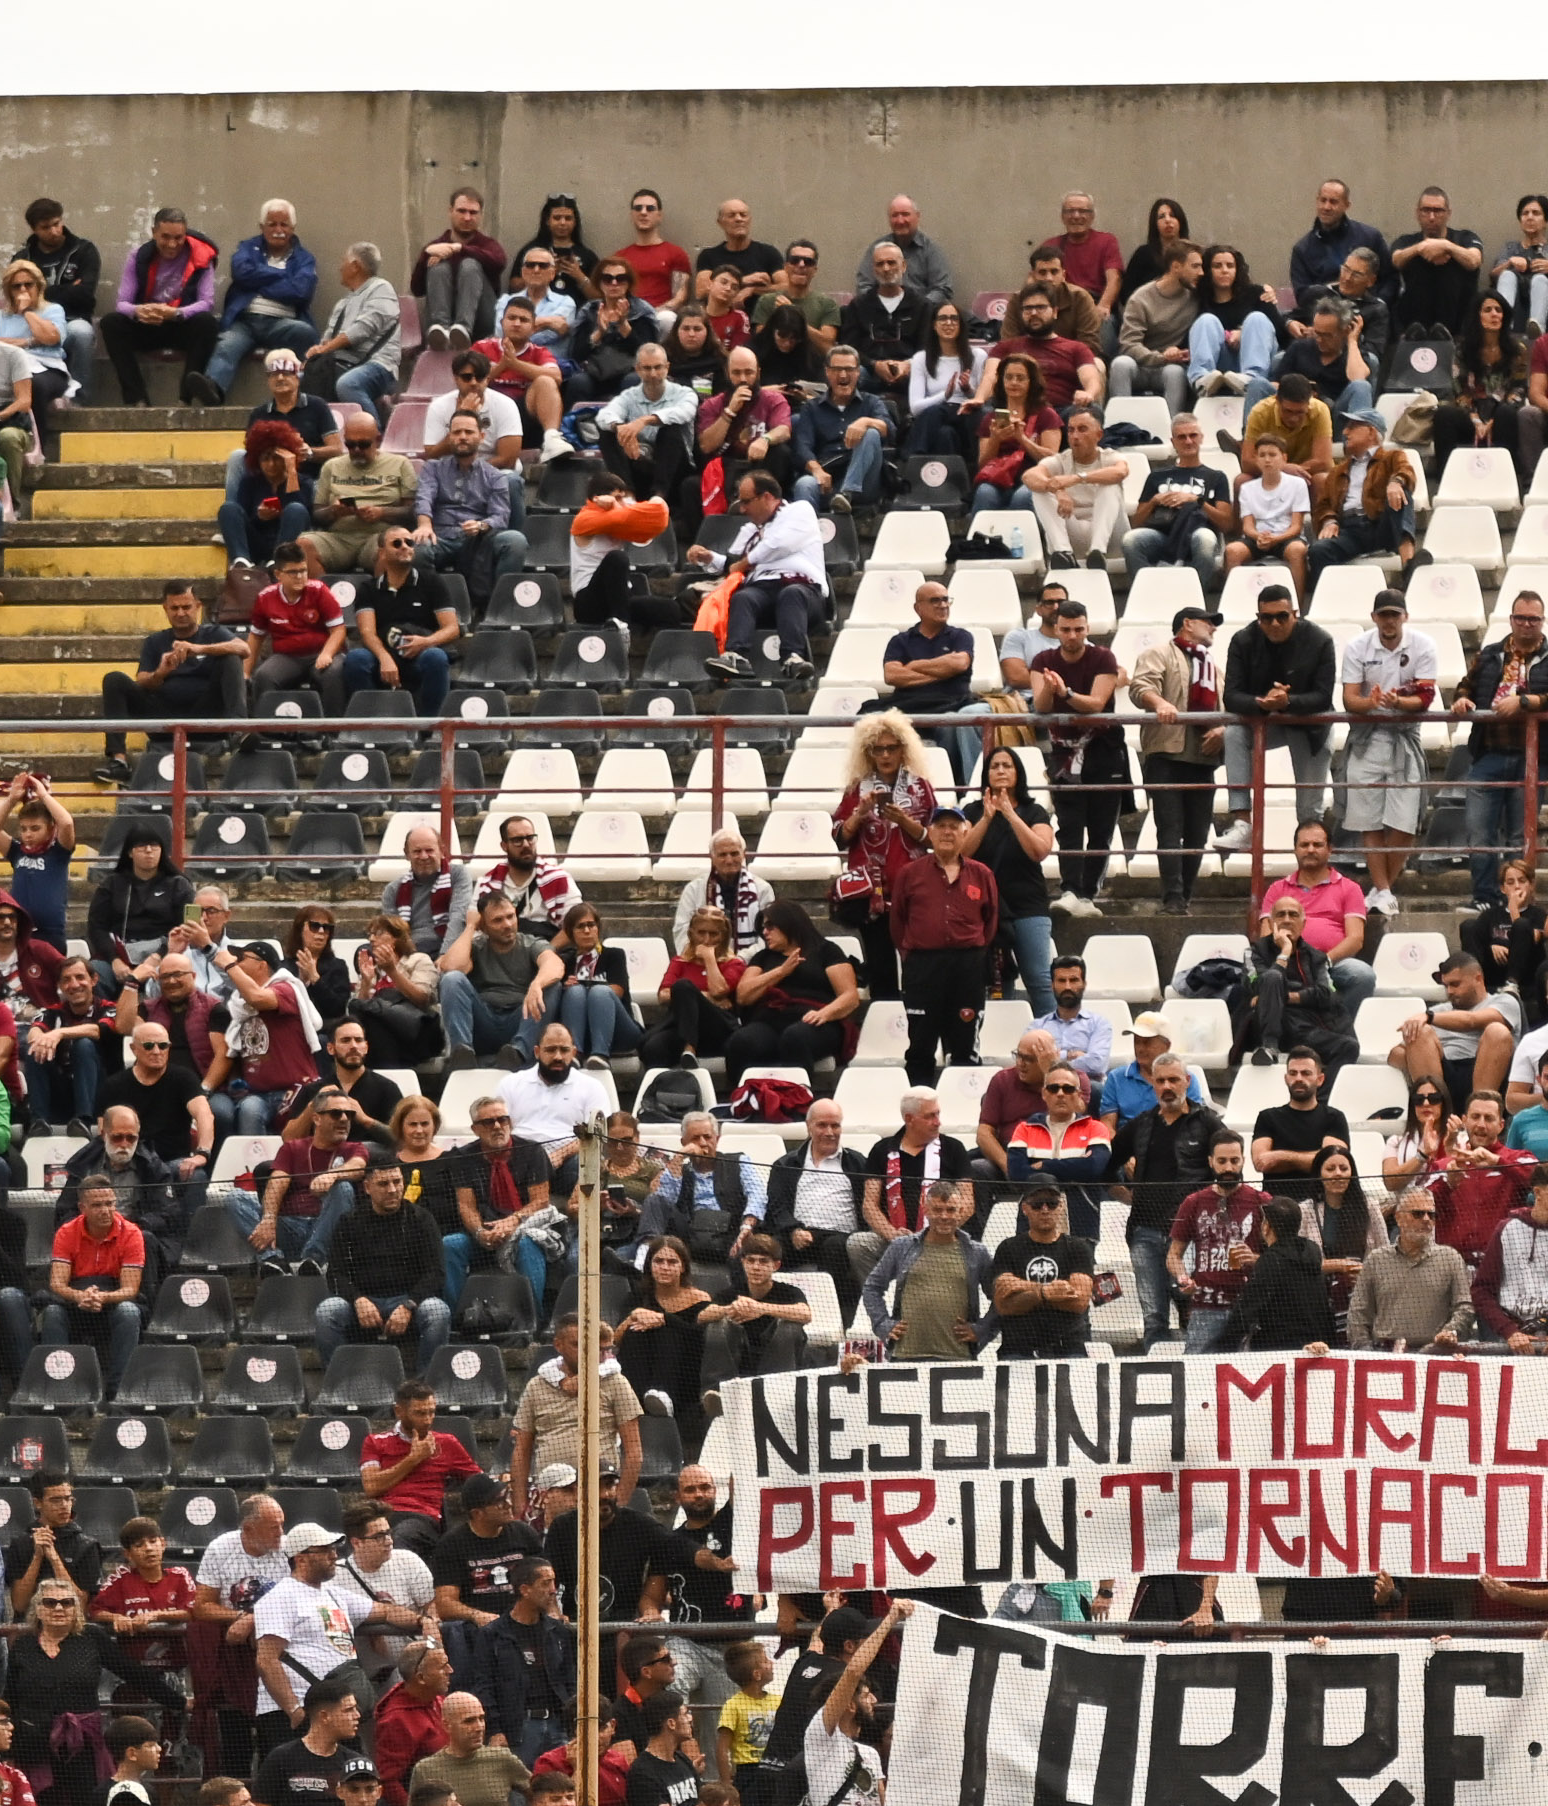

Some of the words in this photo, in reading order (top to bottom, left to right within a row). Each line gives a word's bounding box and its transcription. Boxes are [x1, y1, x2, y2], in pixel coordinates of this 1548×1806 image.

[331, 475, 384, 486] Timberland
[751, 1361, 1186, 1477] NESSUNA
[755, 1476, 938, 1593] PER
[960, 1476, 1080, 1586] UN
[346, 1757, 376, 1773] ICON
